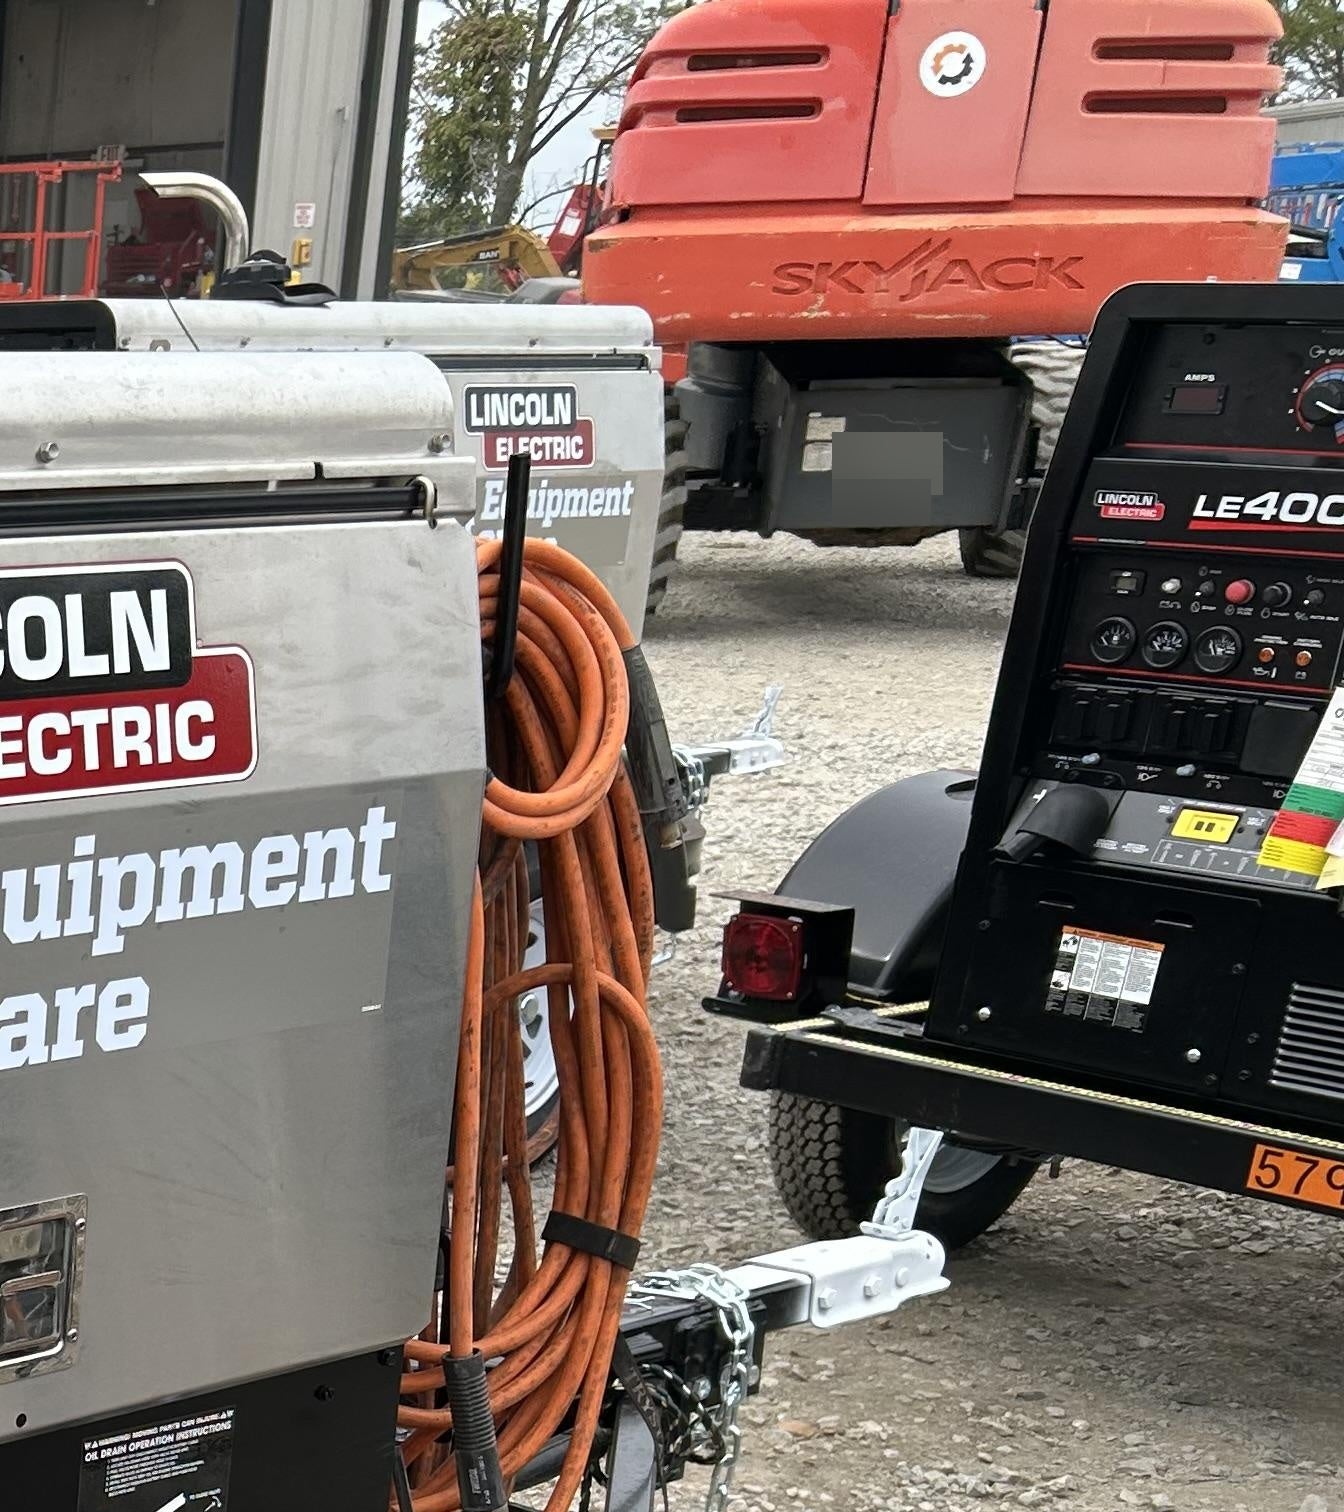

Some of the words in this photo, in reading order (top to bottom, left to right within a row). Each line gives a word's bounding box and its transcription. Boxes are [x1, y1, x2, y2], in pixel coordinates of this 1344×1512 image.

[772, 237, 1085, 303] SKYJACK
[1184, 373, 1215, 383] AMPS
[470, 392, 571, 427] LINCOLN
[496, 435, 584, 462] ELECTRIC
[481, 480, 634, 528] Euipment
[1097, 493, 1153, 506] LINCOLN
[1108, 507, 1157, 518] ELECTRIC
[1193, 491, 1344, 525] LE400
[84, 1451, 98, 1462] OIL
[99, 1444, 127, 1458] DRAIN
[127, 1433, 175, 1451] OPERATION
[174, 1420, 233, 1440] INSTRUCTIONS
